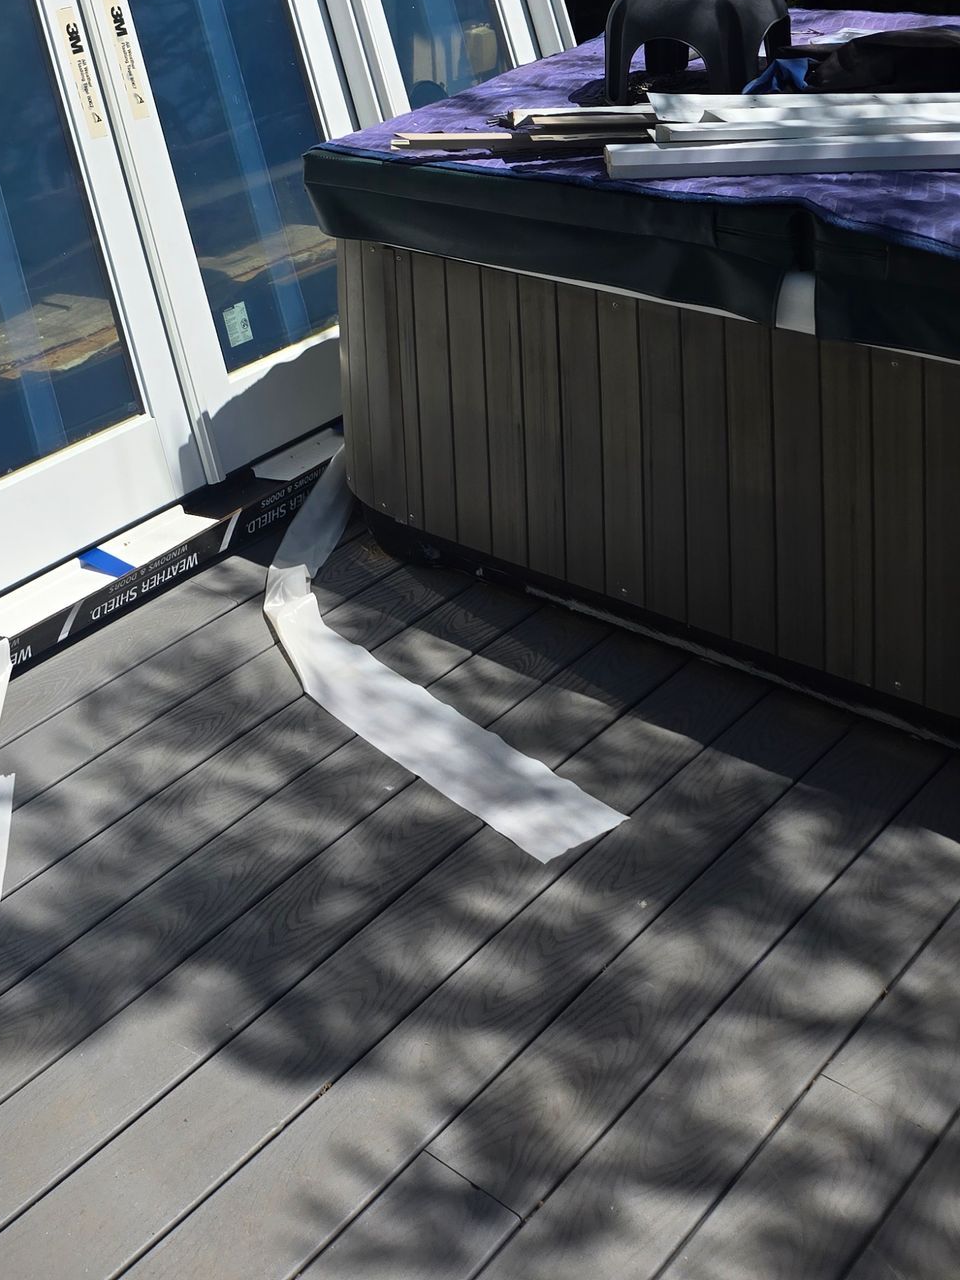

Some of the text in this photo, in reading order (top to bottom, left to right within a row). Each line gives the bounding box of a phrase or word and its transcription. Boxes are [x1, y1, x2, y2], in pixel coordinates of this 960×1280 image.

[110, 5, 128, 37] 3M
[65, 22, 85, 55] 3M
[260, 490, 286, 509] DOORS
[108, 543, 189, 595] WINDOWS & DOORS
[141, 552, 199, 595] WEATHER
